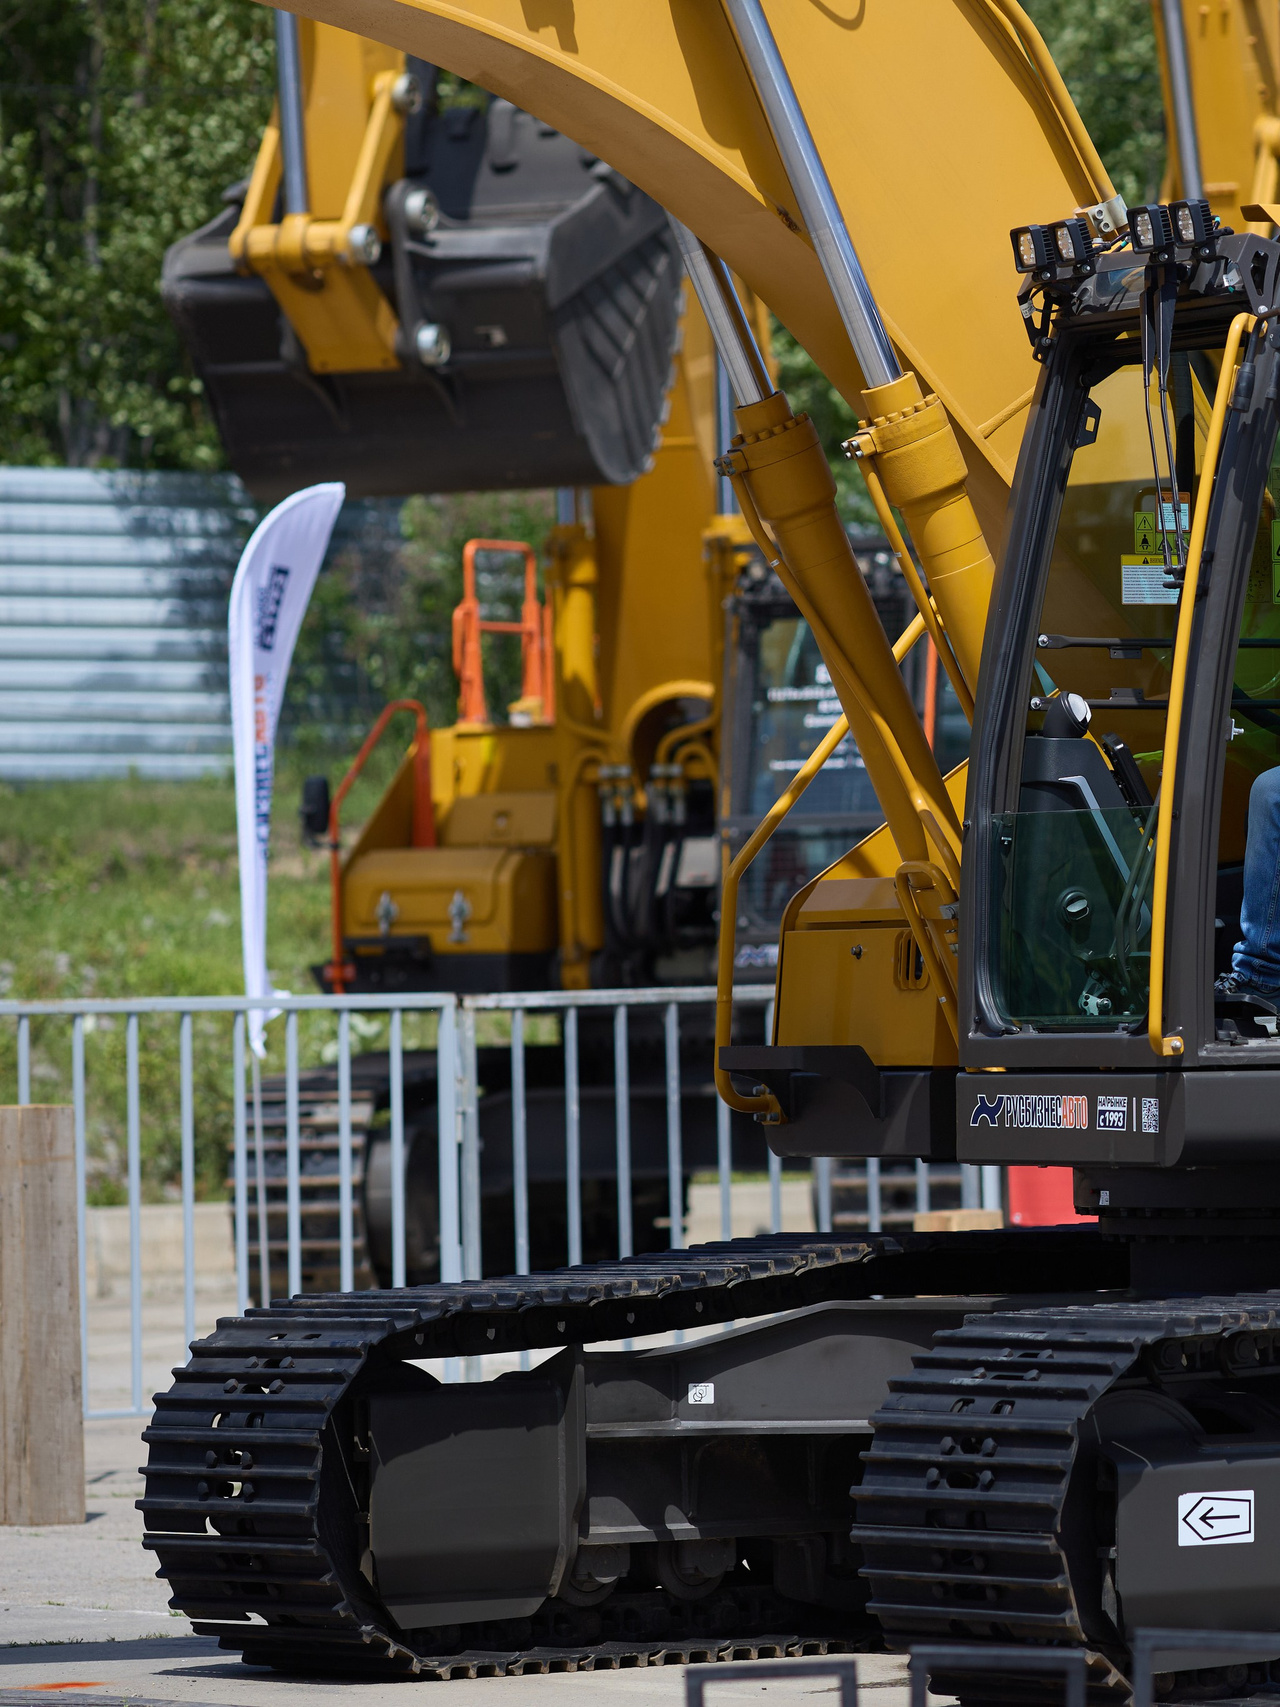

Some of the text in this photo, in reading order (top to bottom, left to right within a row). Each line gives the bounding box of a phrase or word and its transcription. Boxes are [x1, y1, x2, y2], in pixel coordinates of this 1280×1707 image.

[1098, 1097, 1127, 1107] НА РЫНКЕ
[1005, 1095, 1088, 1129] РУСБИЗНЕСАВТО
[1105, 1111, 1124, 1127] 1993
